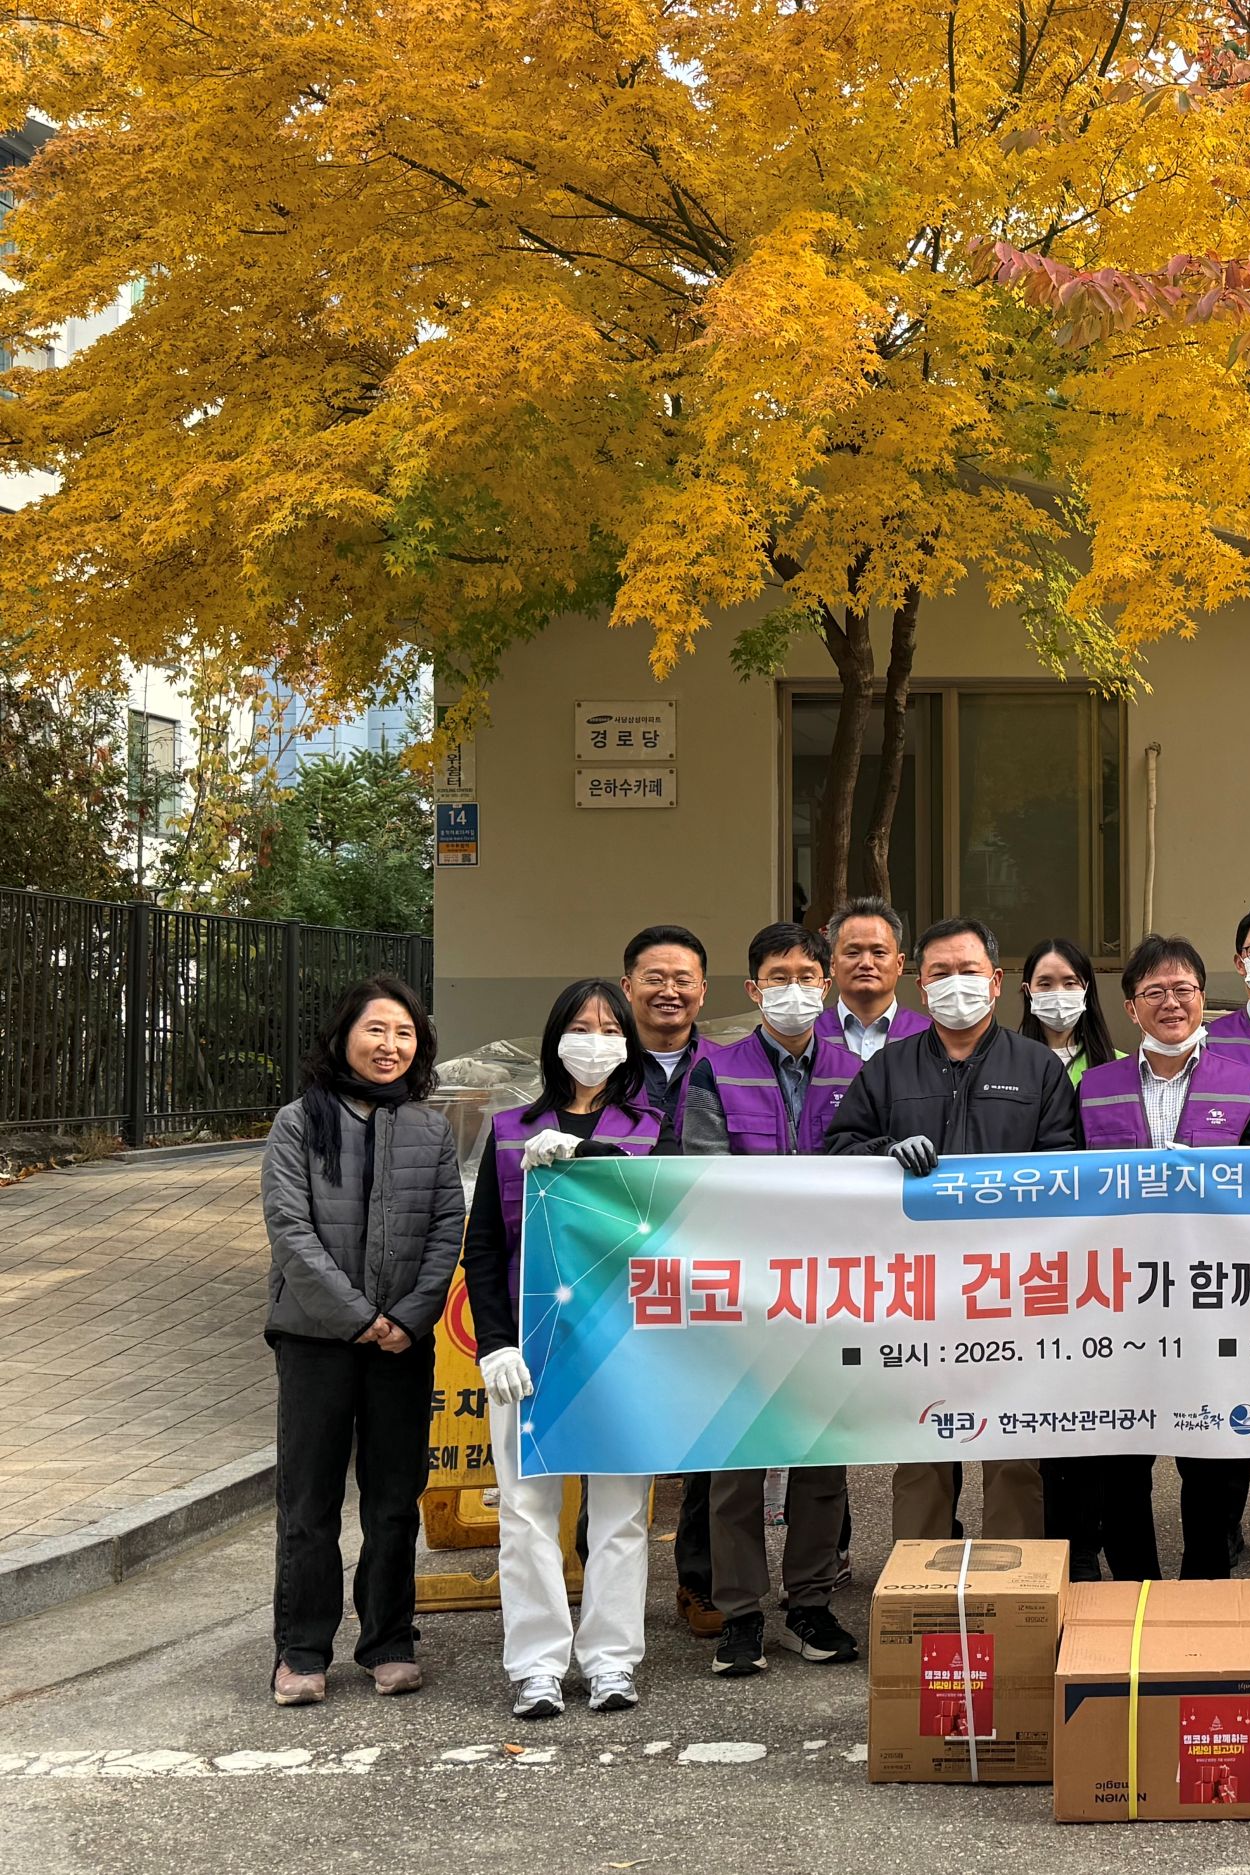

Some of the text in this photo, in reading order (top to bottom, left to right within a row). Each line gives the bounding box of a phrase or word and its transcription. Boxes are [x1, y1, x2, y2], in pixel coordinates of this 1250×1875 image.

[590, 730, 660, 749] 경로당
[588, 778, 662, 797] 은하수카페
[448, 810, 467, 825] 14
[932, 1167, 1079, 1204] 국공유지
[1098, 1162, 1244, 1202] 개발지역
[628, 1257, 743, 1326] 캠코
[767, 1252, 937, 1323] 지자체
[961, 1247, 1175, 1320] 건설사가
[879, 1342, 928, 1368] 일시
[954, 1340, 1023, 1363] 2025.
[1036, 1338, 1072, 1360] 11.
[1082, 1337, 1114, 1358] 08
[1157, 1337, 1182, 1358] 11
[931, 1409, 1157, 1439] 캠코 한국자산관리공사
[429, 1445, 459, 1470] 조에
[953, 1671, 988, 1680] 함하는
[928, 1681, 951, 1690] 사랑의
[1184, 1734, 1248, 1744] 캠코와 함께하는
[1188, 1745, 1244, 1755] 사랑의 집고치기
[1095, 1781, 1129, 1791] magic
